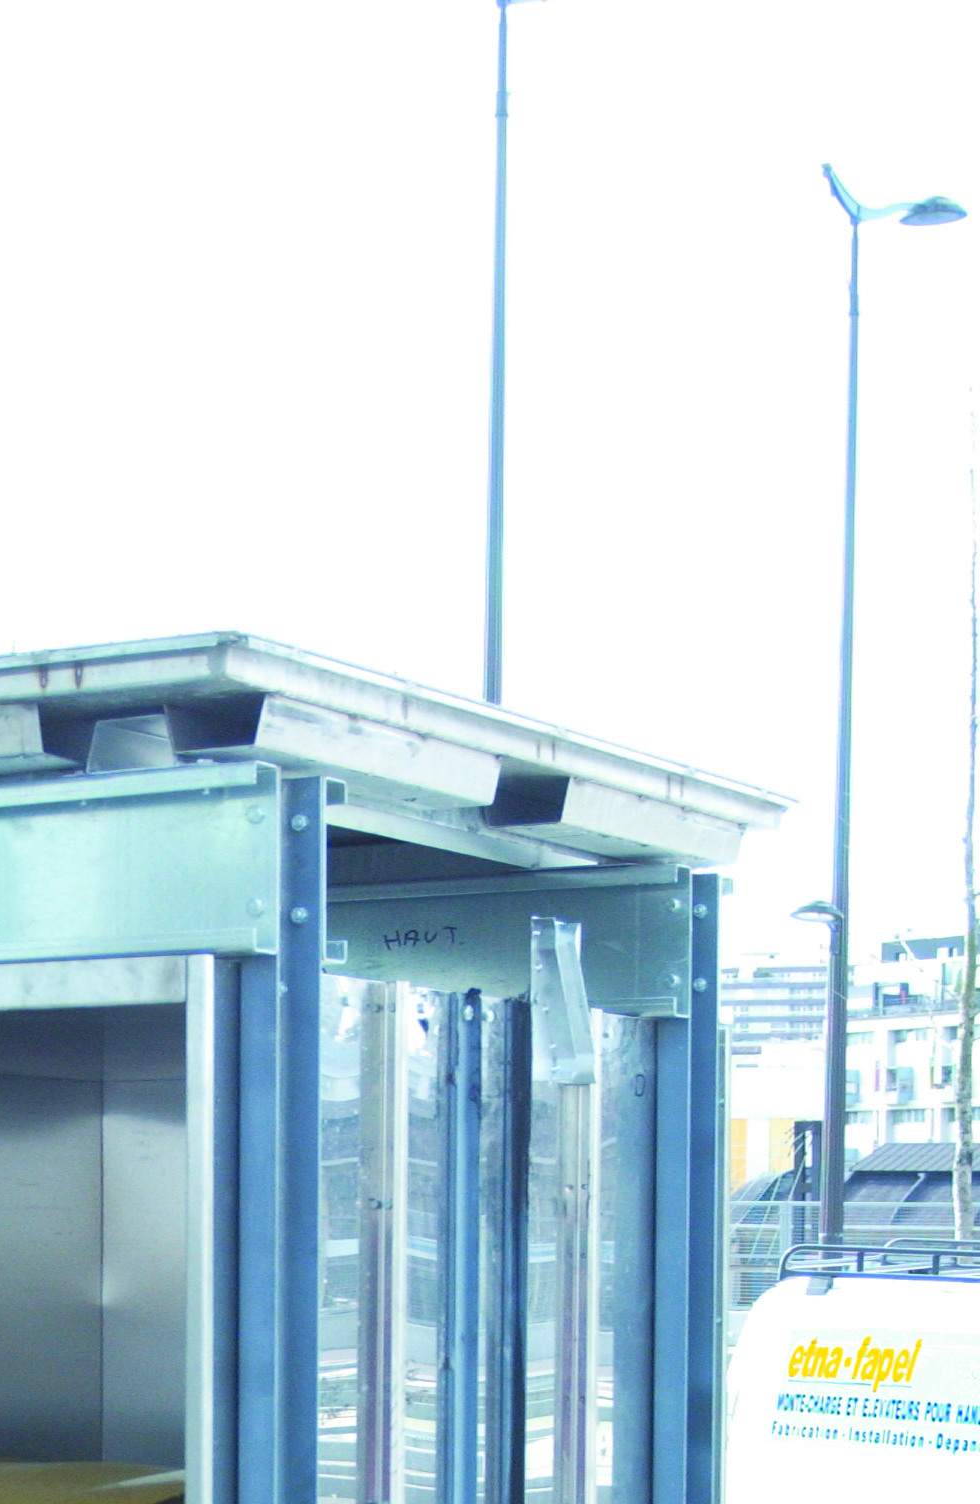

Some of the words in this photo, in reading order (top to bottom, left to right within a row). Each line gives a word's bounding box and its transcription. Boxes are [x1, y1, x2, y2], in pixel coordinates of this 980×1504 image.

[845, 1397, 859, 1416] ET
[924, 1401, 952, 1423] POUR
[771, 1420, 839, 1440] Fabrication
[848, 1426, 925, 1448] Installation
